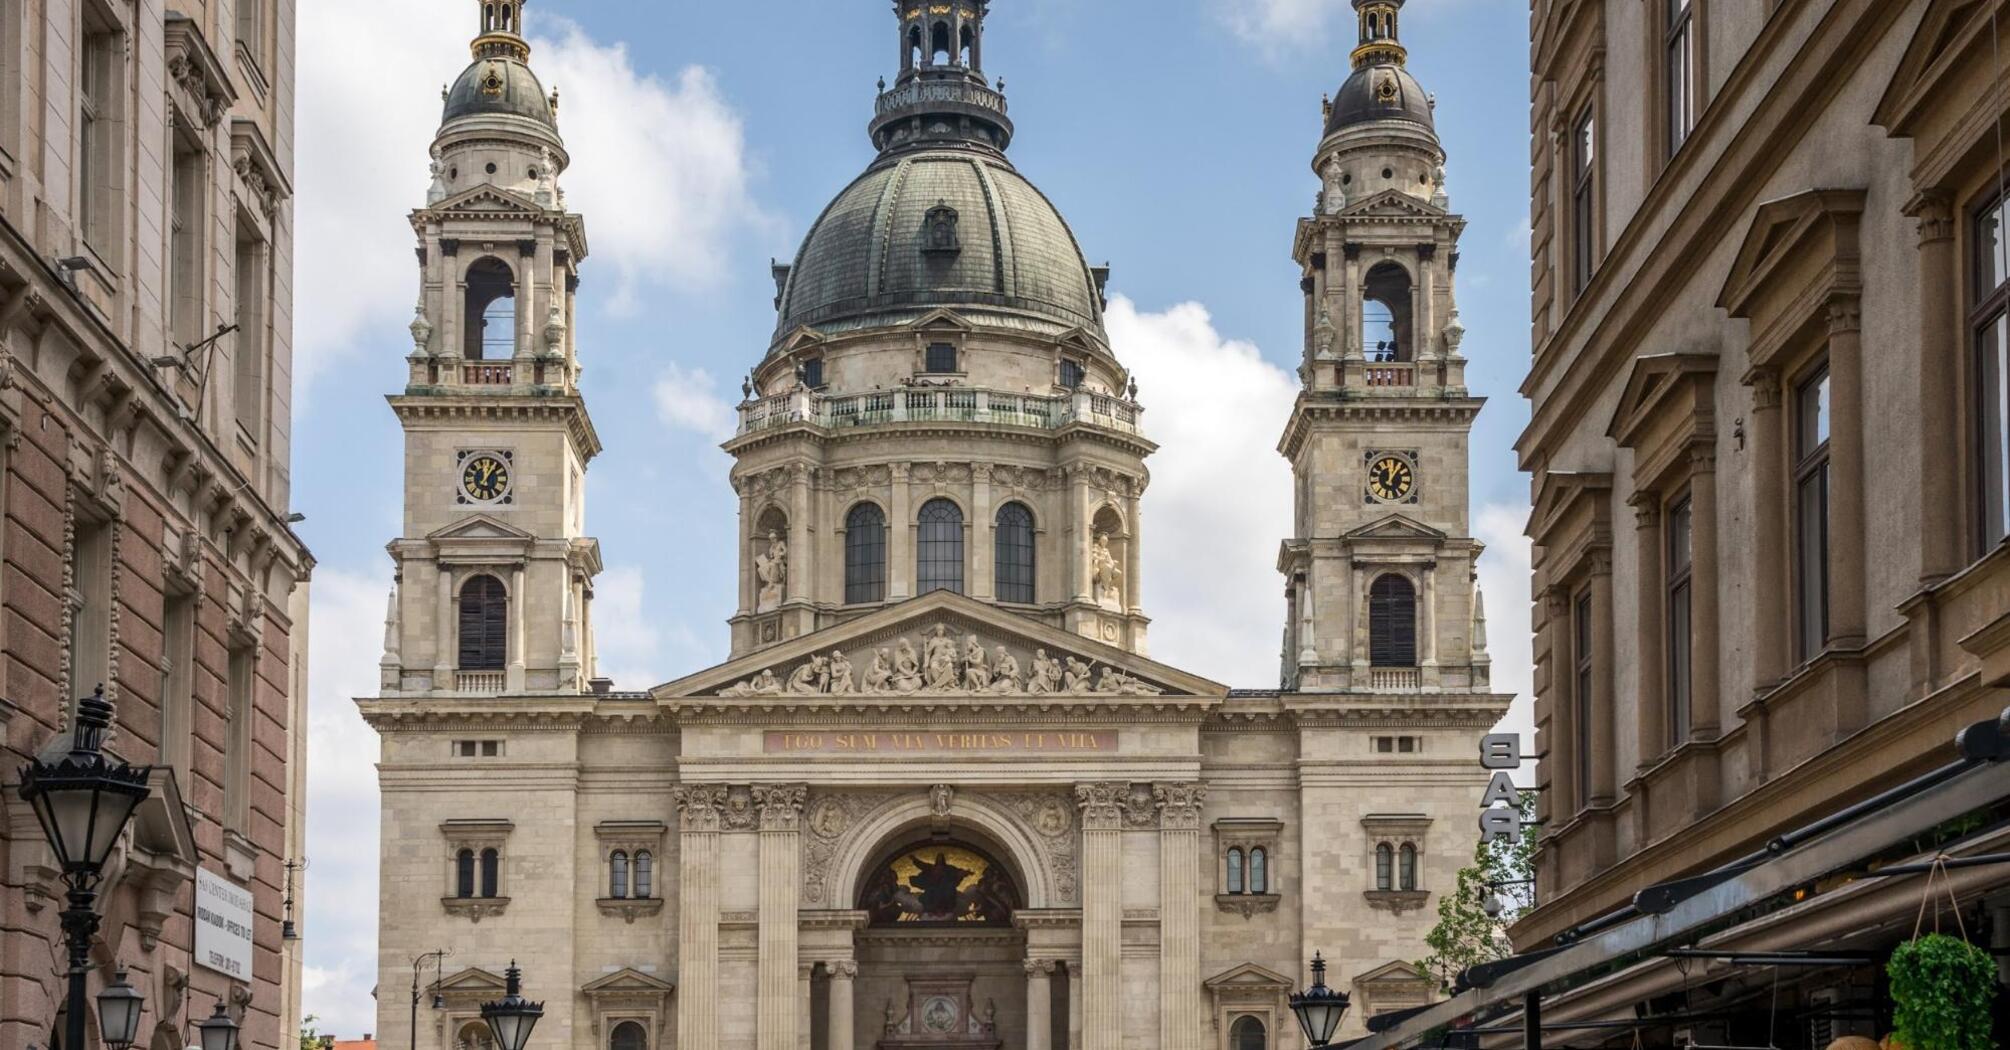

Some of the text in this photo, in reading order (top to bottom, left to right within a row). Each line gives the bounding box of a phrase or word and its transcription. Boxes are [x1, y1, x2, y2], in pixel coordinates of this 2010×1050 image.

[891, 734, 925, 749] VIA
[935, 734, 1013, 749] VERITAS
[1057, 733, 1098, 749] VITA
